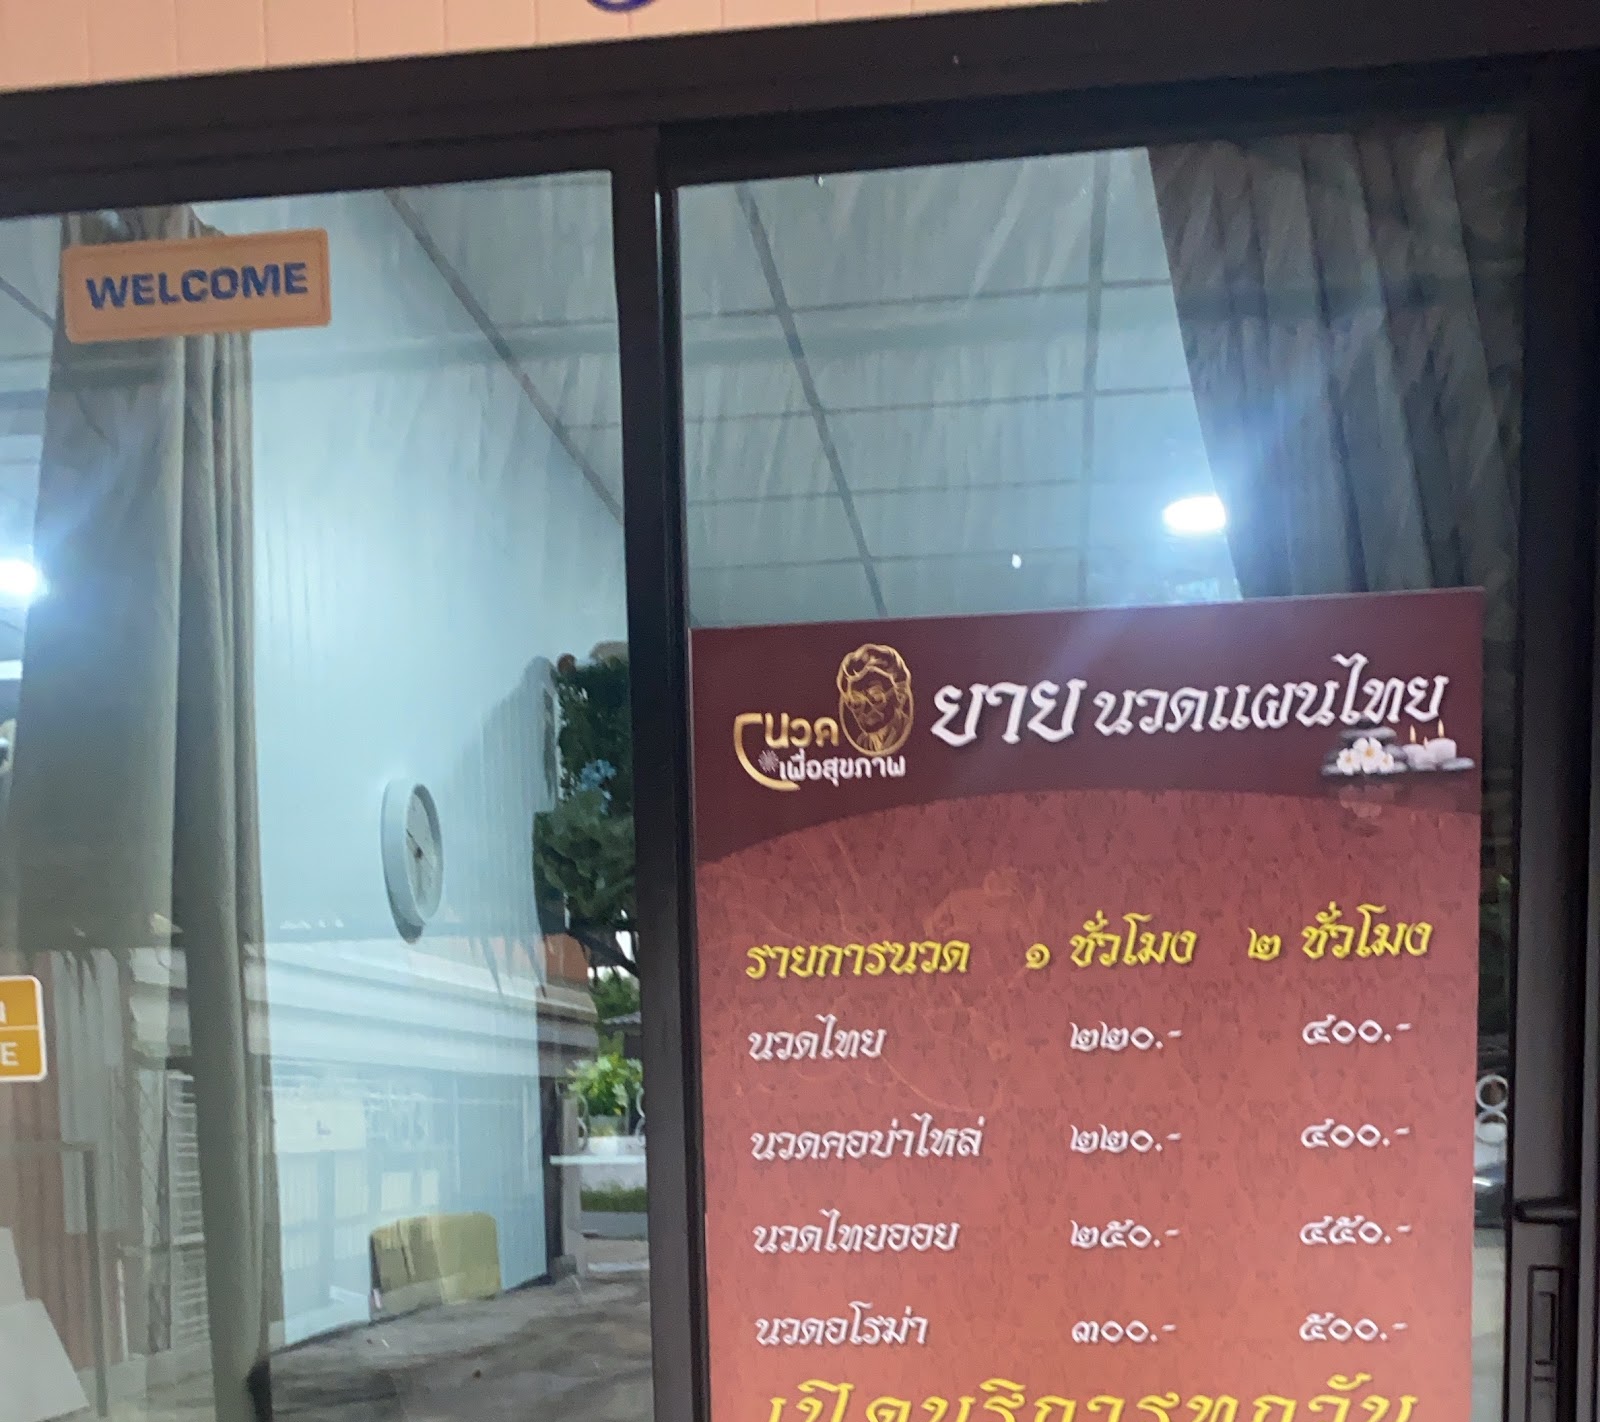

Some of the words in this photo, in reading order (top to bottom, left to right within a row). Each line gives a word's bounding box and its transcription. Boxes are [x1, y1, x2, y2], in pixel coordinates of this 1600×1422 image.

[85, 262, 309, 310] WELCOME
[931, 678, 1088, 747] ยาย
[1094, 652, 1450, 737] นวดแผนไทย
[779, 747, 906, 788] เพื่อสุขภาพ
[745, 939, 971, 979] รายการนวด
[1025, 942, 1051, 970] ๑
[1068, 909, 1198, 969] ชั่วโมง
[1247, 927, 1282, 962] ๒
[1301, 901, 1433, 960] ชั่วโมง
[748, 1013, 886, 1061] นวดไทย
[751, 1112, 985, 1161] นวดคอบ่าไหล่
[753, 1208, 960, 1253] นวดไทยออย
[755, 1301, 929, 1346] นวดอโรม่า
